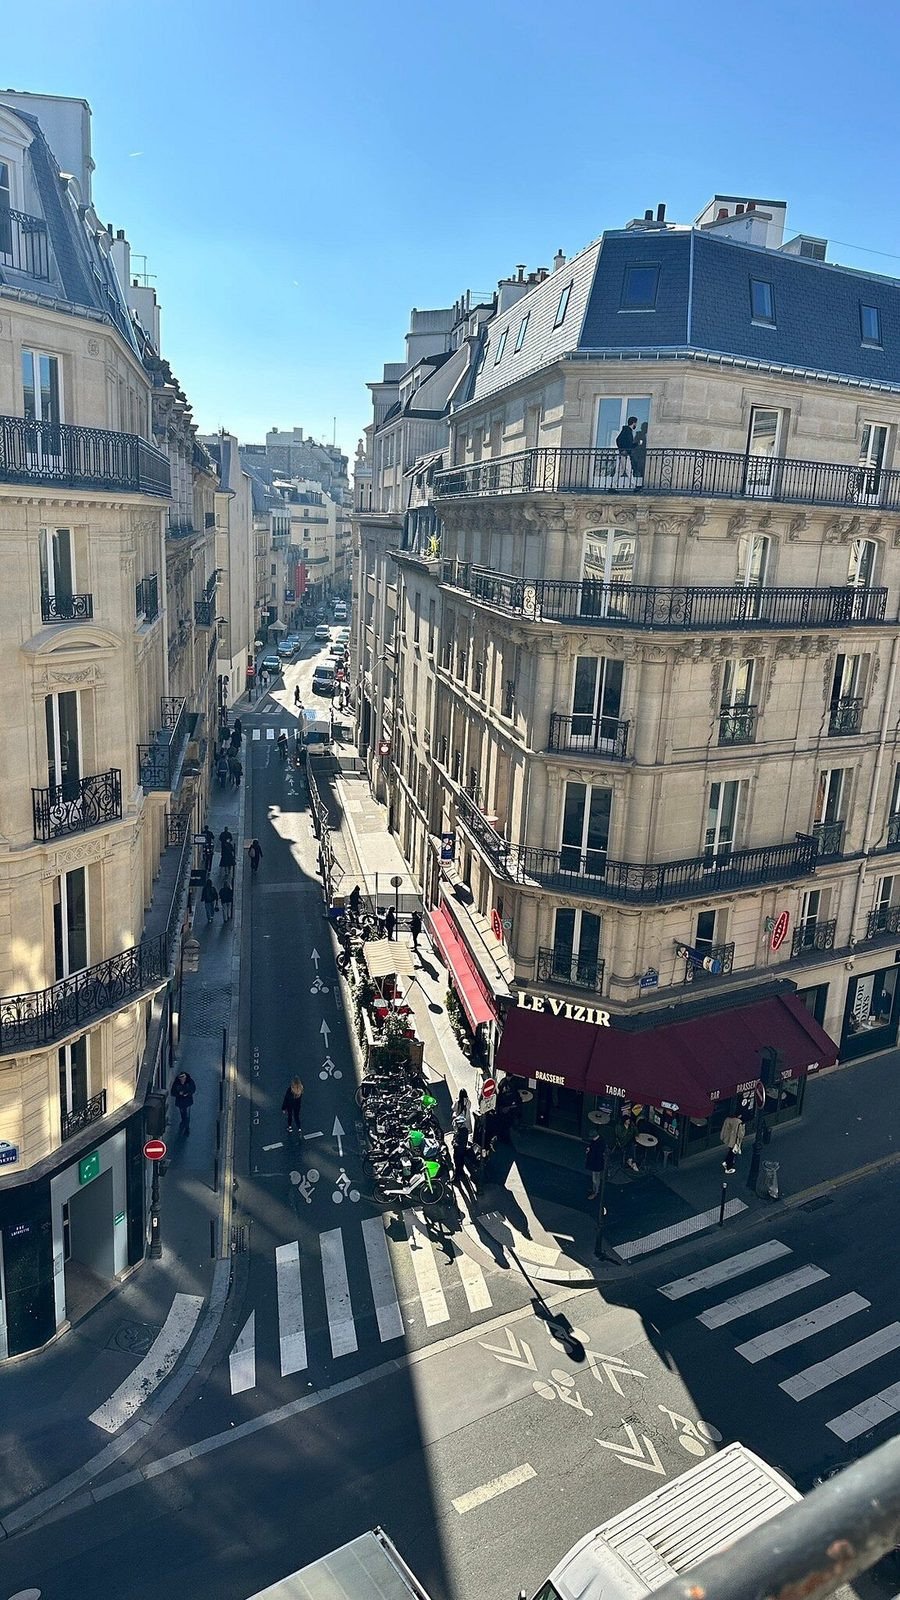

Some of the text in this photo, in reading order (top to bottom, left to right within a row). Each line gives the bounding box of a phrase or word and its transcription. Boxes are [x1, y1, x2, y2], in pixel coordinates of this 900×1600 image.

[516, 991, 611, 1028] LE VIZIR
[535, 1070, 566, 1086] BRASSERIE
[605, 1084, 626, 1098] TABAC
[710, 1090, 720, 1101] BAR
